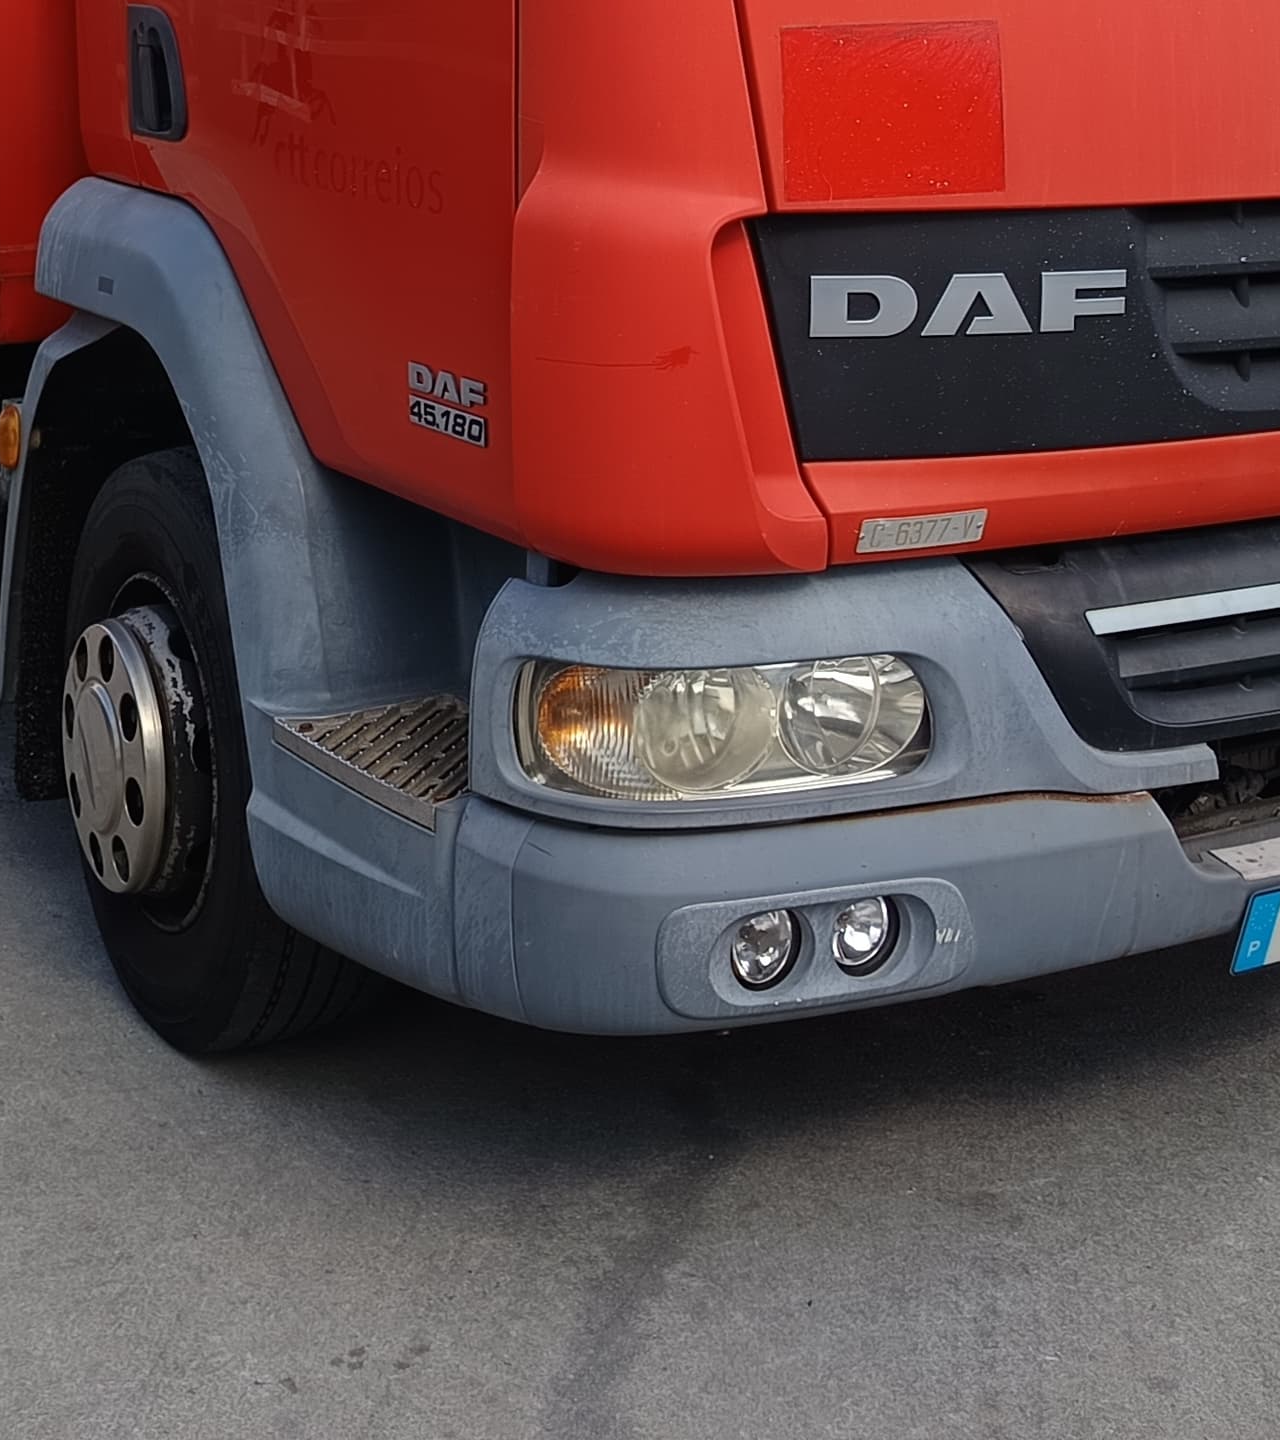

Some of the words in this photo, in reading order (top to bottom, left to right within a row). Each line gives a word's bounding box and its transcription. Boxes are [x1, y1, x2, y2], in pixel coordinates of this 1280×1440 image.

[808, 268, 1127, 338] DAF
[407, 360, 487, 408] DAF
[408, 399, 485, 443] 45.180
[1246, 940, 1261, 957] P
